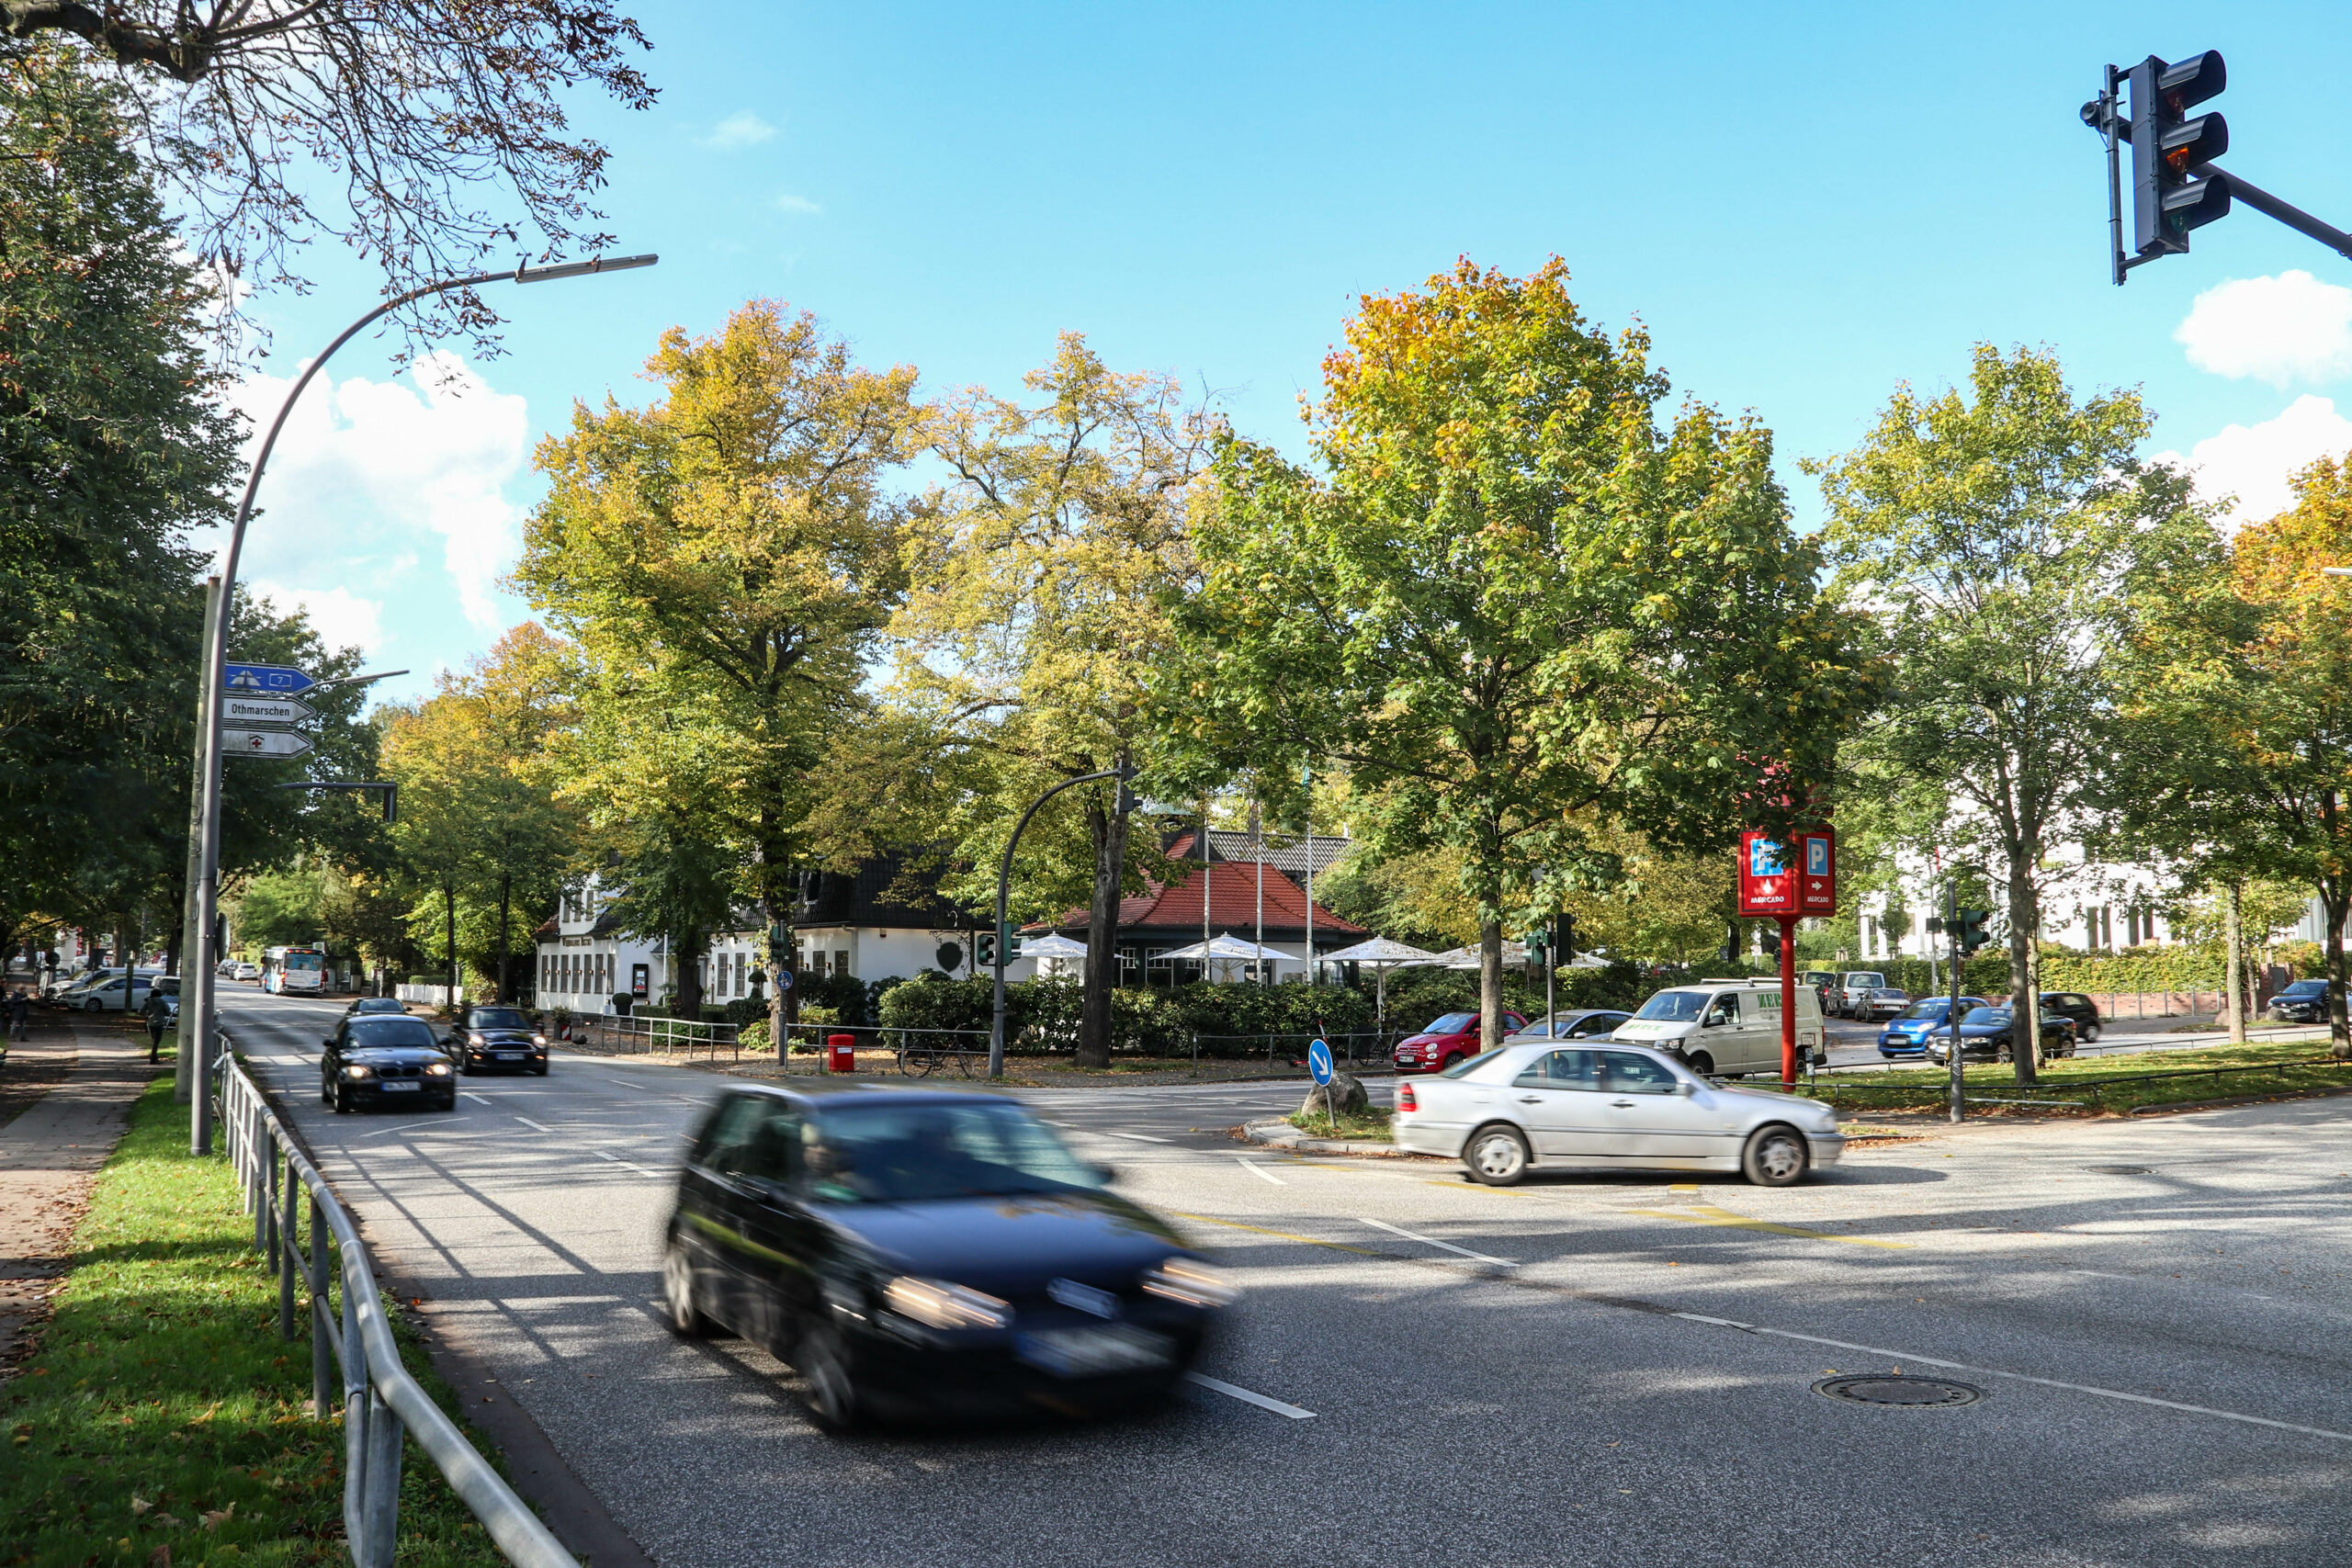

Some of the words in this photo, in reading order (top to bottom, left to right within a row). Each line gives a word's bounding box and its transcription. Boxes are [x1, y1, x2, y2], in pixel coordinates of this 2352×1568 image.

[277, 676, 283, 684] 7
[232, 704, 290, 716] Othmarschen
[1811, 844, 1824, 870] P
[1750, 896, 1785, 904] MERCADO
